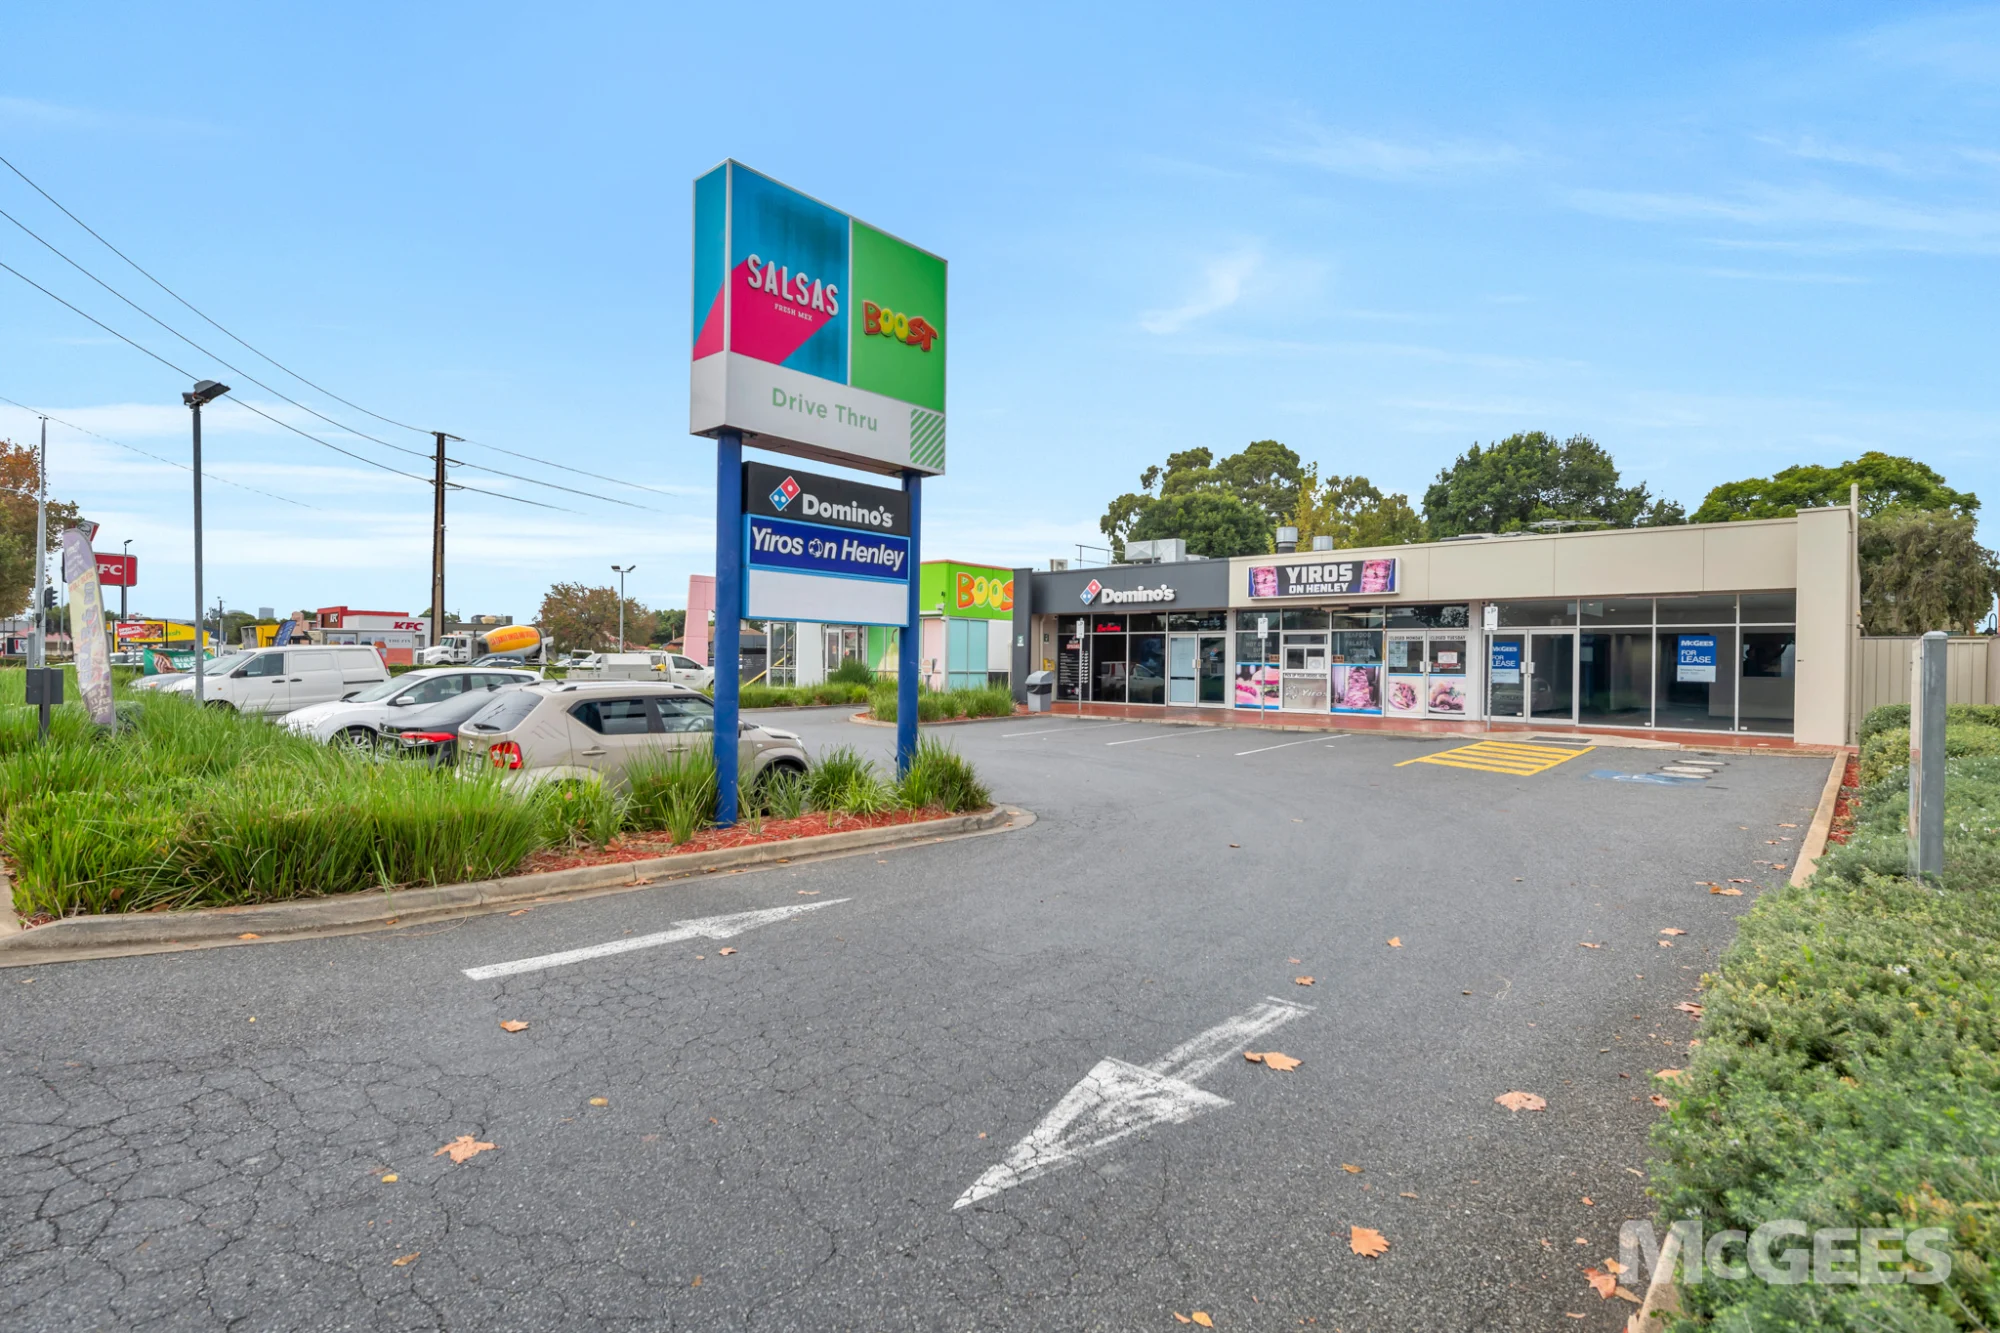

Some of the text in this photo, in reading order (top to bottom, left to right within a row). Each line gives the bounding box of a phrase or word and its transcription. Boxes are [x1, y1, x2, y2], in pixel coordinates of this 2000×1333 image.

[747, 253, 840, 317] SALSAS
[774, 303, 813, 323] FRESH MEX
[862, 299, 939, 352] BOOST
[772, 387, 878, 432] Drive Thru
[802, 493, 893, 528] Domino's
[751, 525, 804, 556] Yiros
[841, 538, 905, 572] Henley
[96, 563, 122, 575] FC
[1285, 563, 1353, 584] YIROS
[1101, 584, 1176, 604] Domino's
[1288, 582, 1349, 594] ON HENLEY
[329, 613, 338, 623] KFC
[393, 621, 424, 631] KFC
[1681, 655, 1712, 664] LEASE
